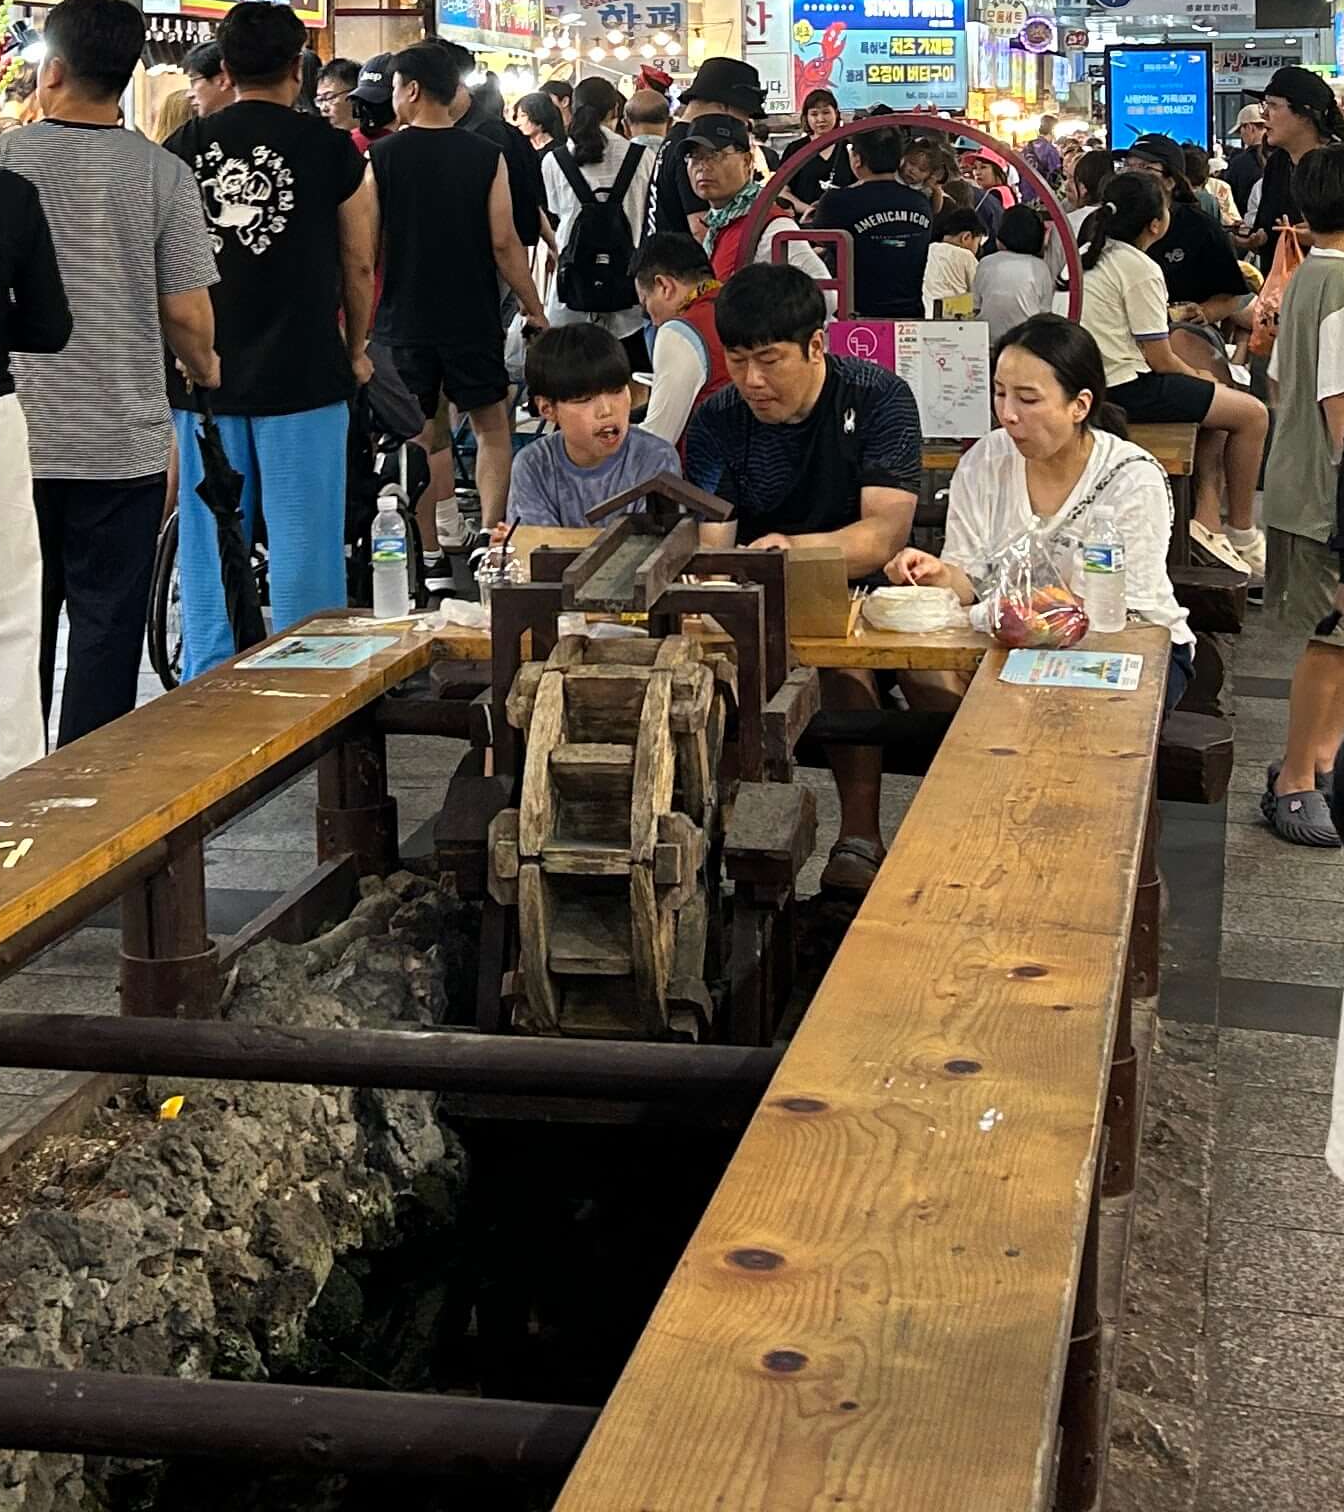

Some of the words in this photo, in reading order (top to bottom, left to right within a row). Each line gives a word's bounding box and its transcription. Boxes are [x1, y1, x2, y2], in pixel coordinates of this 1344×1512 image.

[890, 37, 916, 55] 치즈
[867, 65, 905, 83] 오징어
[907, 65, 954, 83] 버터구이
[854, 210, 908, 233] AMERICAN
[910, 211, 930, 228] ICON
